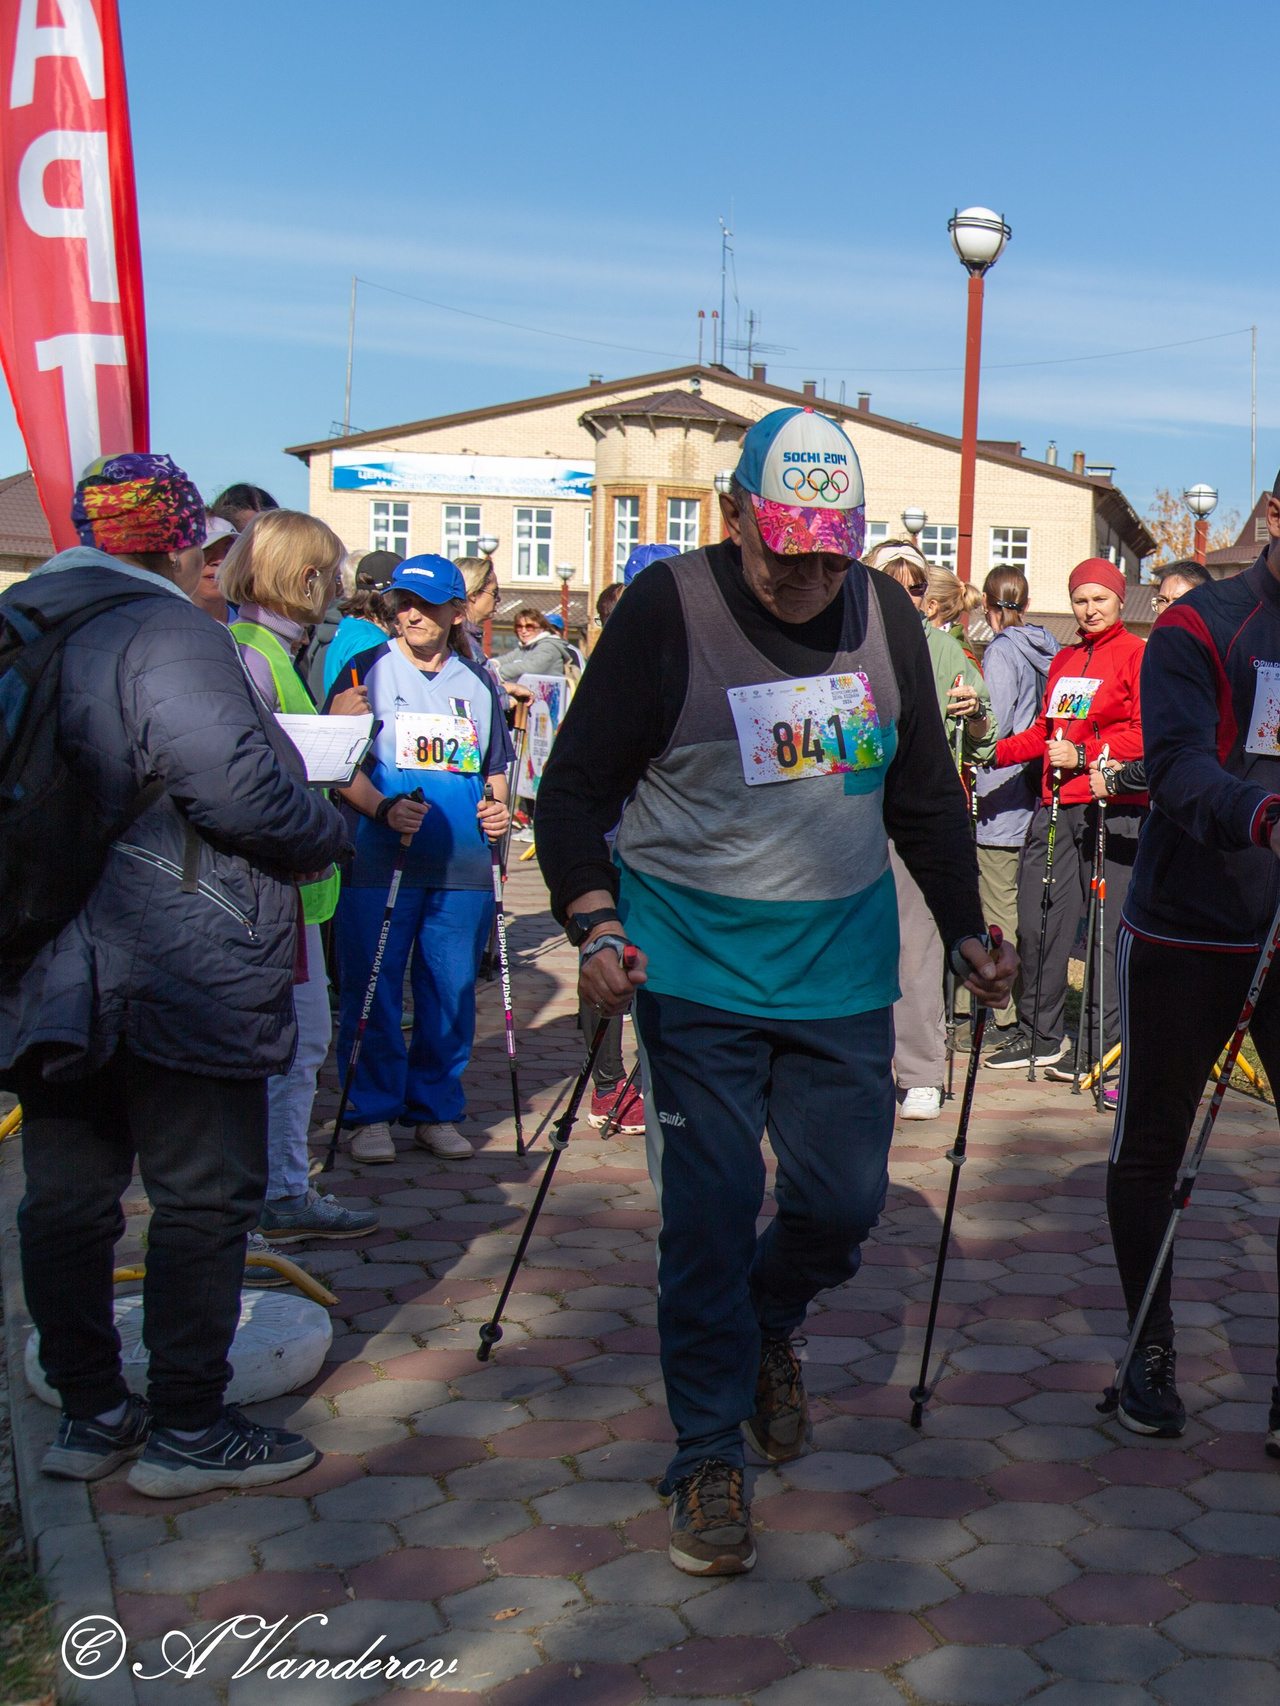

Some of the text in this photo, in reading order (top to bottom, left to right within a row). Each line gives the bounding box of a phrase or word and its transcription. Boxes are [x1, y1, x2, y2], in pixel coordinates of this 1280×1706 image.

[783, 451, 847, 466] SOCHI 2014
[1057, 693, 1083, 713] 823
[416, 735, 460, 765] 802
[772, 714, 847, 769] 841
[372, 919, 391, 974] СЕВЕРНАЯ
[497, 913, 509, 966] СЕВЕРНАЯ
